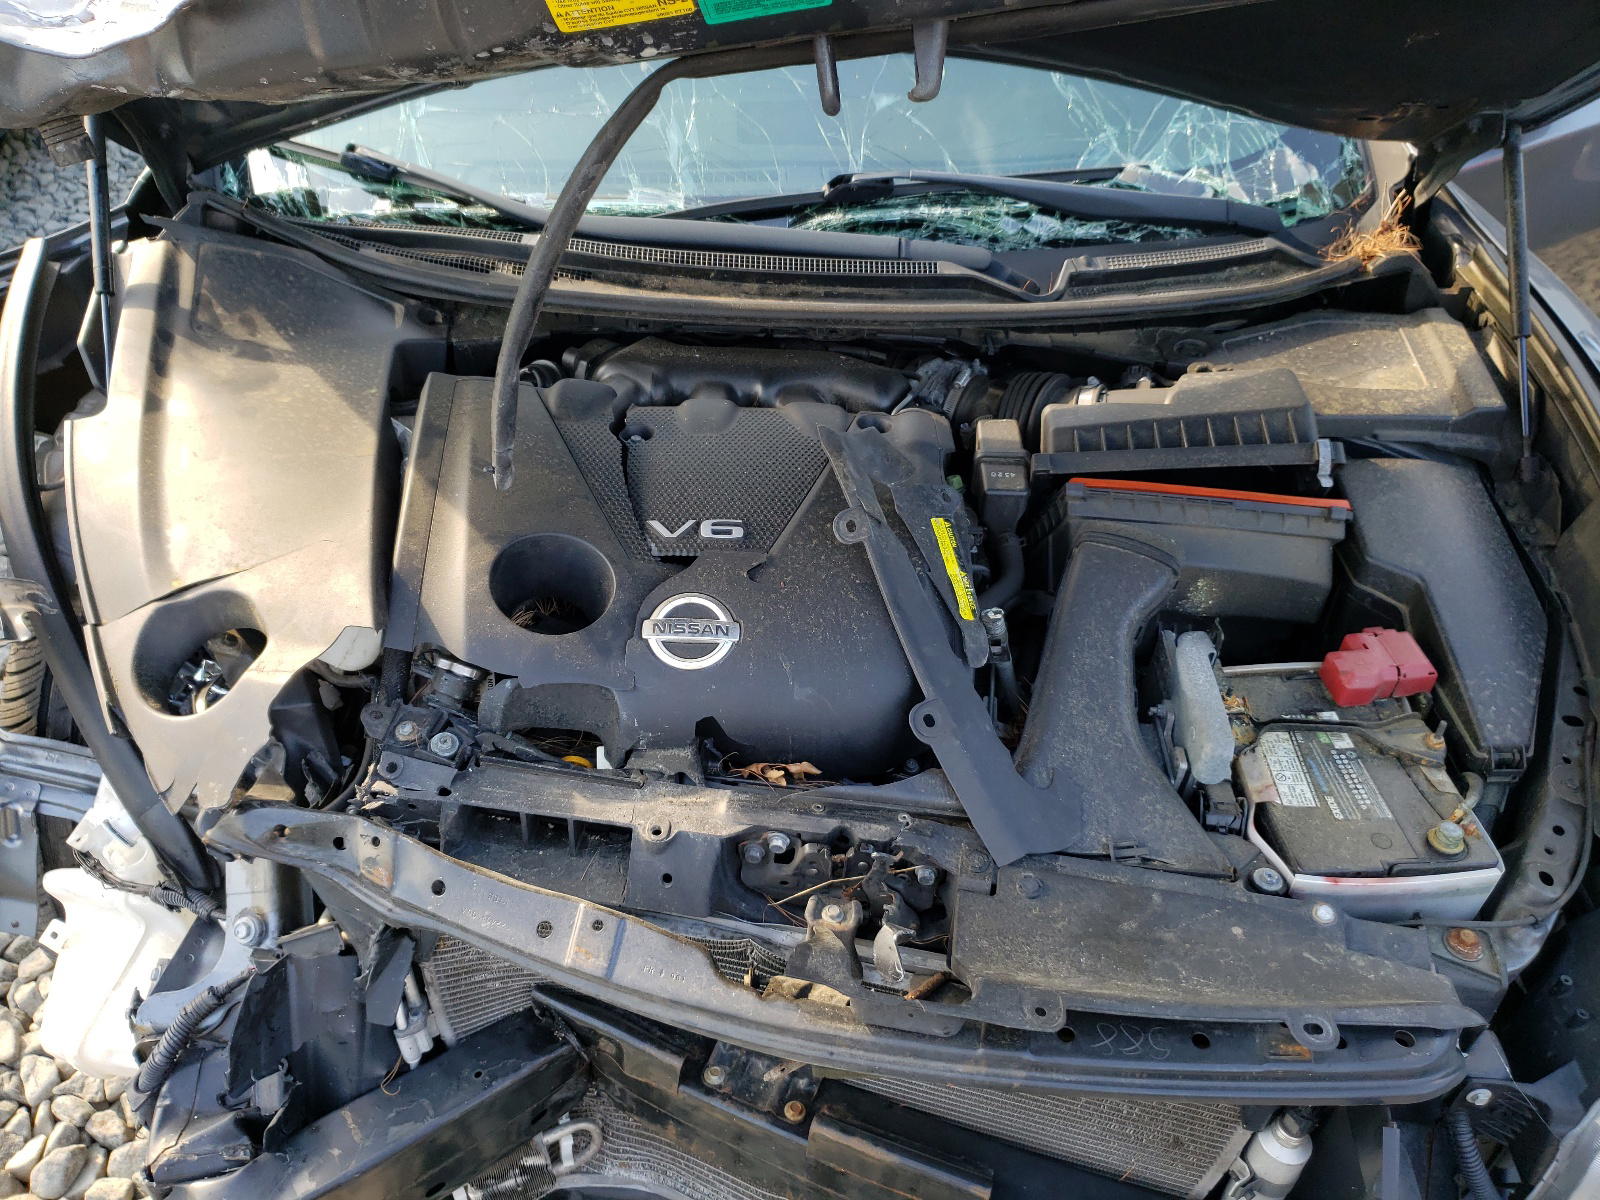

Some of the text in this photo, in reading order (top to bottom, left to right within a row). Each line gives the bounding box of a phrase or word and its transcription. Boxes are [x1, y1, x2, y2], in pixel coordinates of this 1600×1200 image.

[565, 5, 615, 17] ATTENTION
[646, 519, 744, 538] V6
[652, 621, 730, 636] NISSAN
